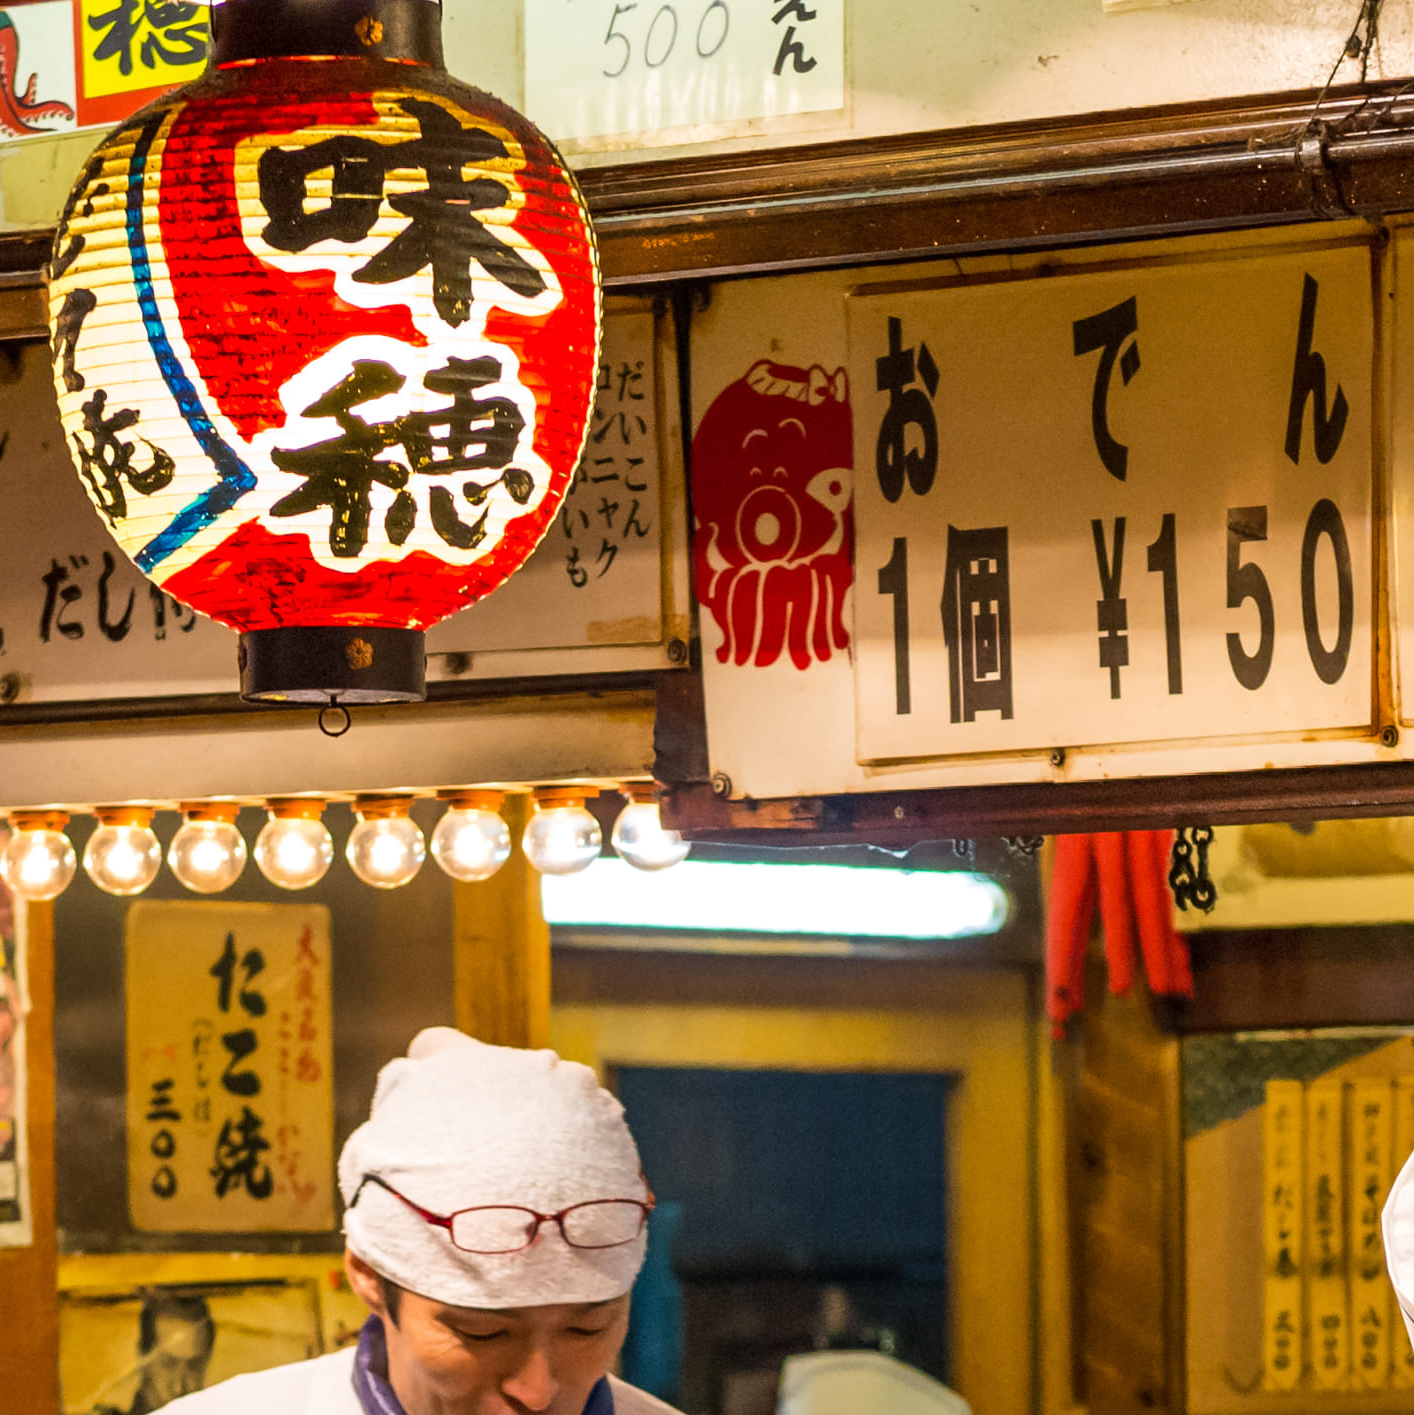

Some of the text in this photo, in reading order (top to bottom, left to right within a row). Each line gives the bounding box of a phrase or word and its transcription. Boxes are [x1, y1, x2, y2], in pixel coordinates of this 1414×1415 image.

[257, 97, 547, 558] 味穂
[876, 271, 1350, 504] おでん
[616, 360, 650, 539] だいこん
[877, 498, 1355, 724] 1個 ¥150
[209, 930, 274, 1200] たこ焼
